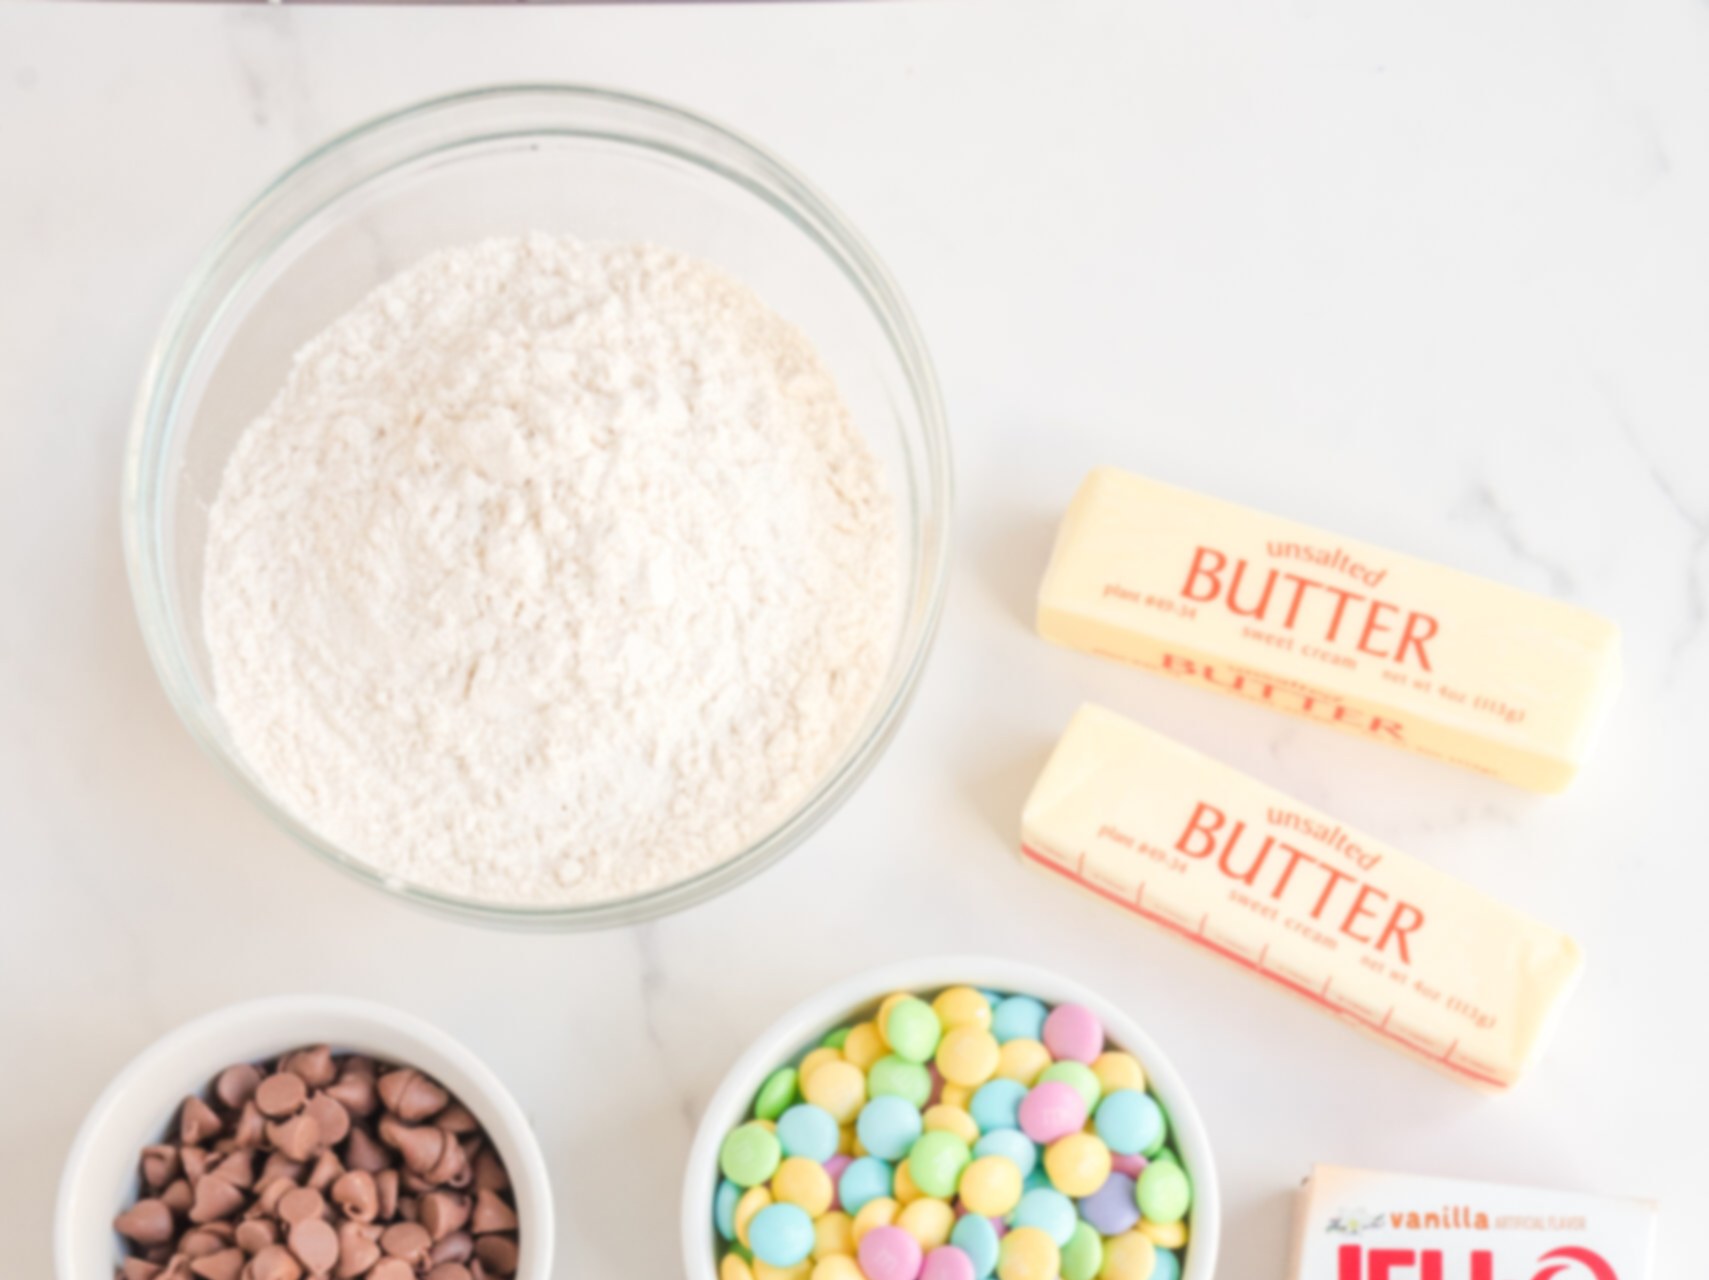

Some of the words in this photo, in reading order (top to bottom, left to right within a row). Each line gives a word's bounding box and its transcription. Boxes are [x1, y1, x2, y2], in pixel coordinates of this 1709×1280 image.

[1266, 539, 1388, 589] unsalted
[1180, 545, 1440, 673] BUTTER
[1242, 626, 1294, 651] sweet
[1300, 643, 1358, 670] cream
[1162, 653, 1404, 740] BUTTER
[1266, 805, 1384, 873] unsalted
[1173, 801, 1426, 967] BUTTER
[1228, 889, 1279, 921] sweet
[1283, 917, 1339, 951] cream
[1390, 1205, 1490, 1231] vanilla
[1549, 1216, 1587, 1231] FLAVOR
